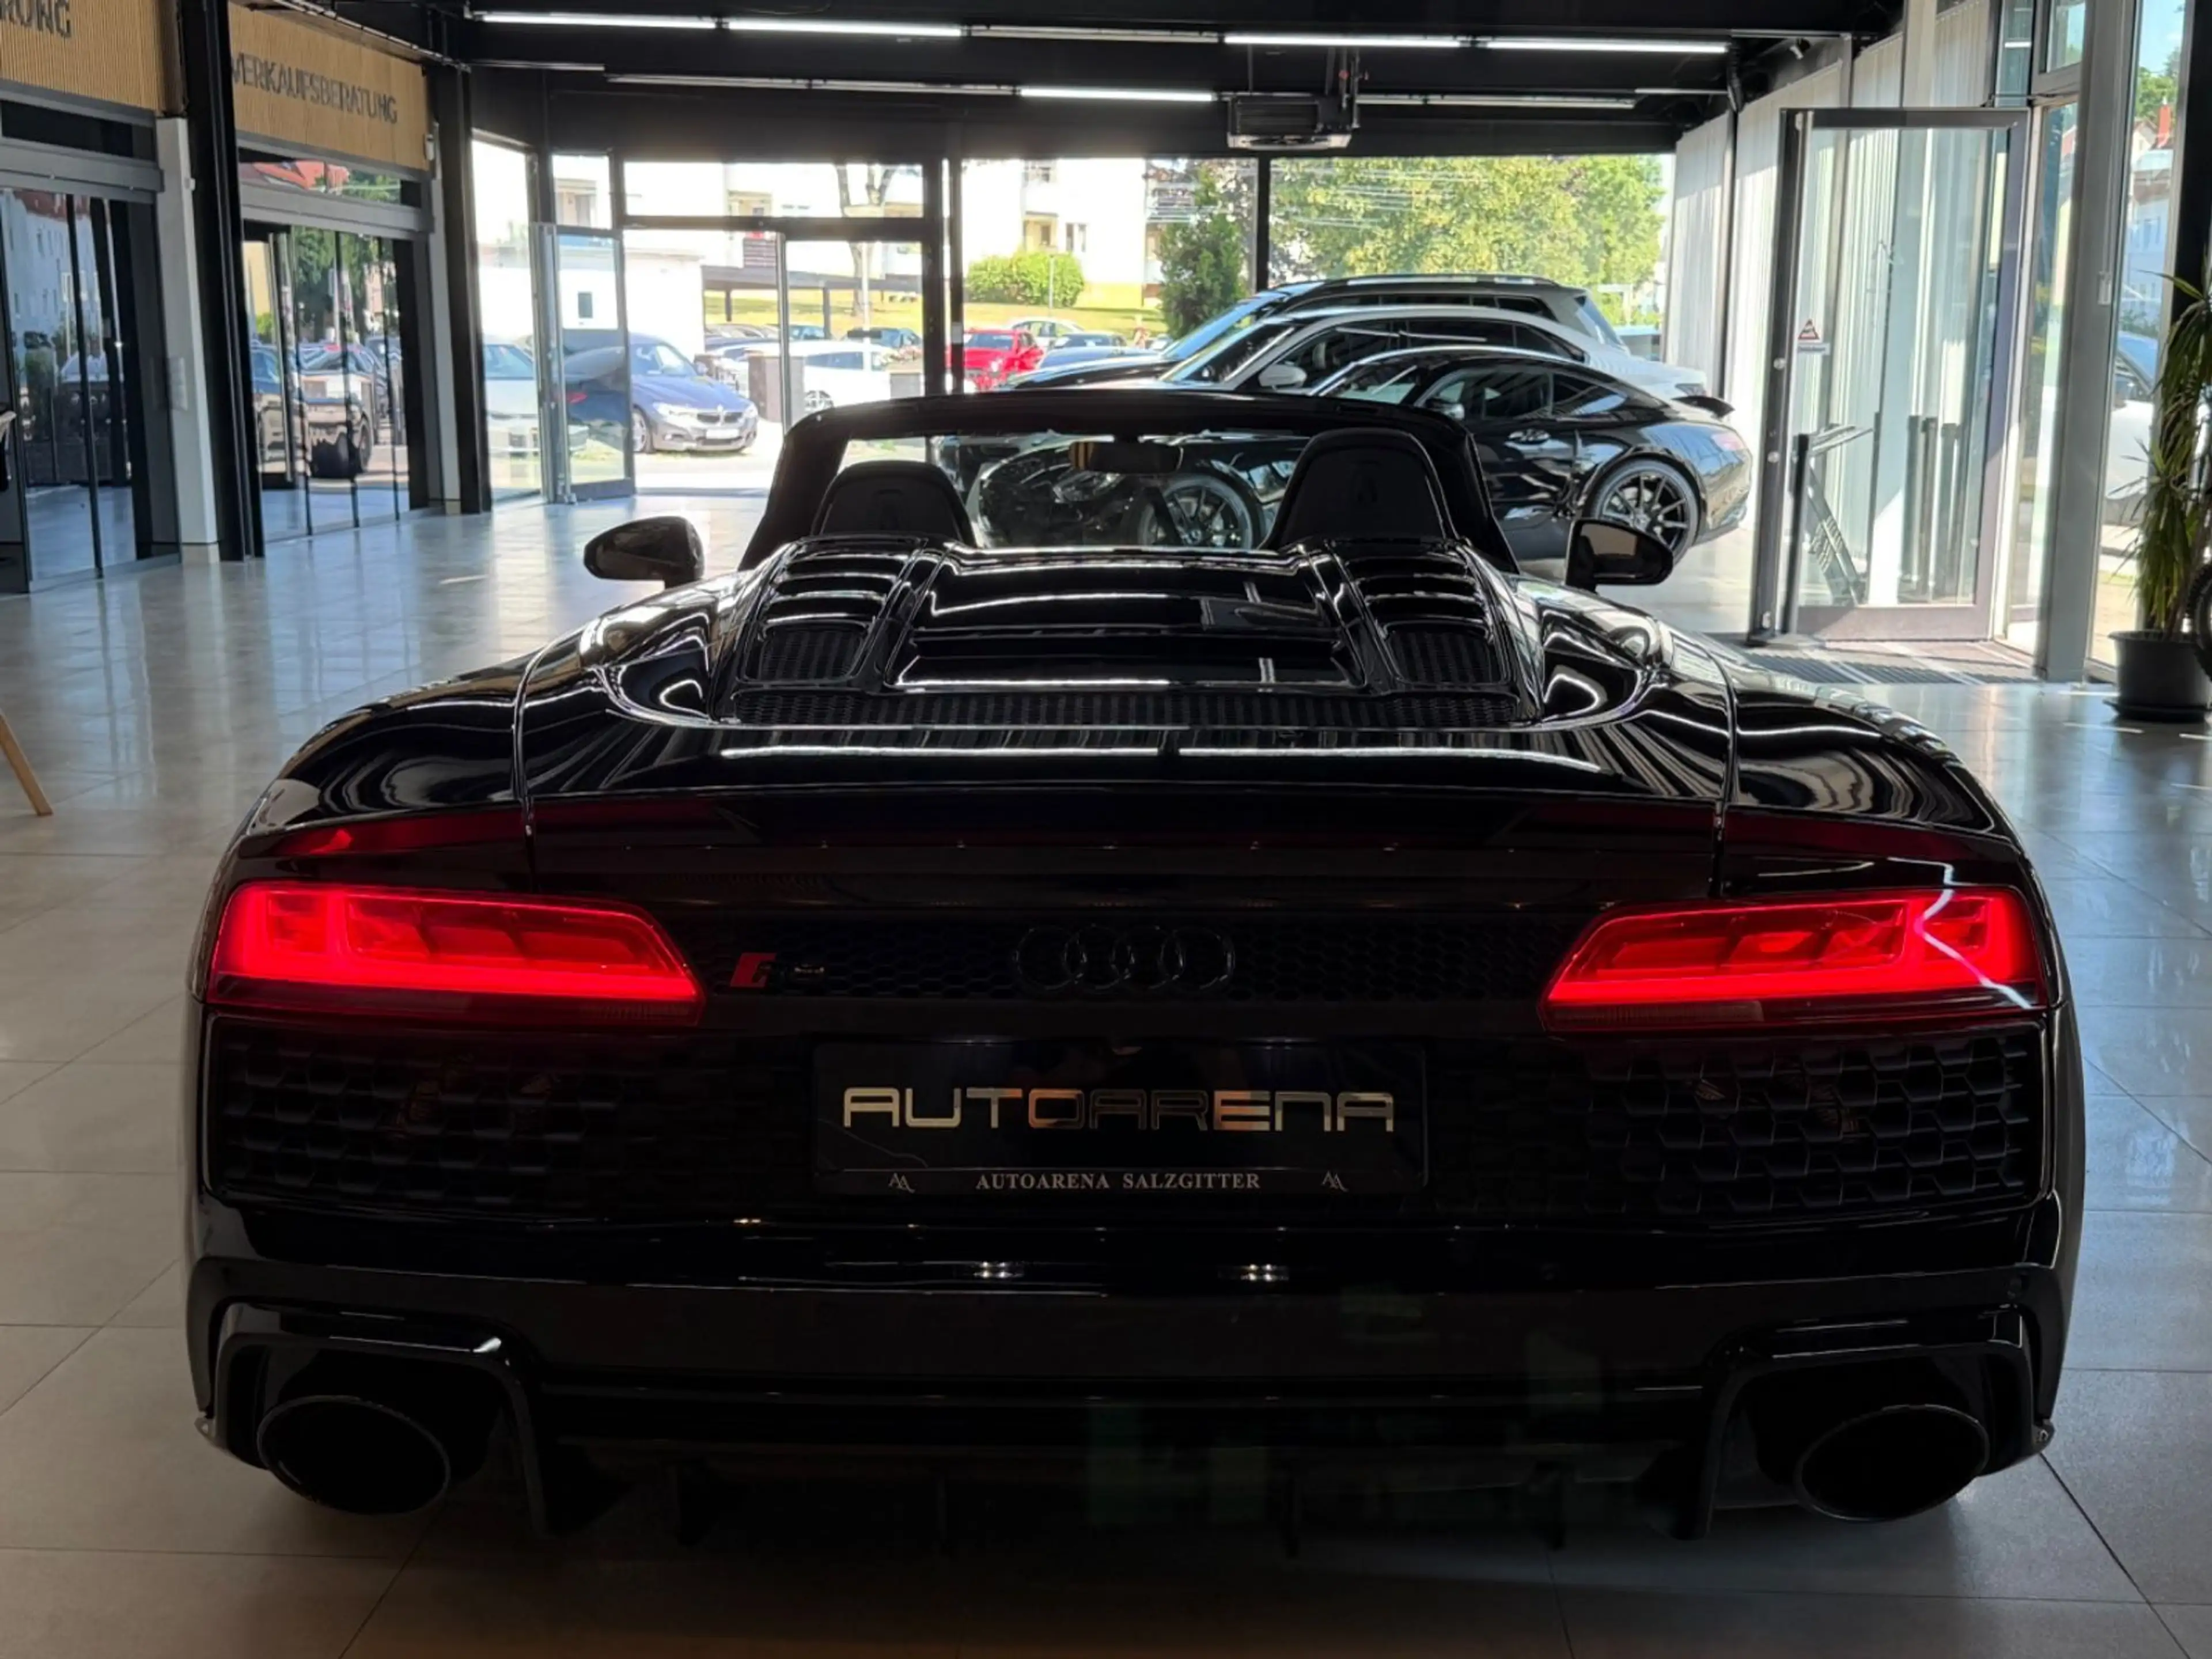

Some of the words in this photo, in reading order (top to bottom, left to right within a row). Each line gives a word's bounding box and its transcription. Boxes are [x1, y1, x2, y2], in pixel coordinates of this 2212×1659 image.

[231, 52, 397, 124] VERKAUFSBERATUNG
[843, 1086, 1393, 1132] AUTOARENA
[975, 1172, 1109, 1190] AUTOARENA
[1122, 1172, 1261, 1190] SALZGITTER
